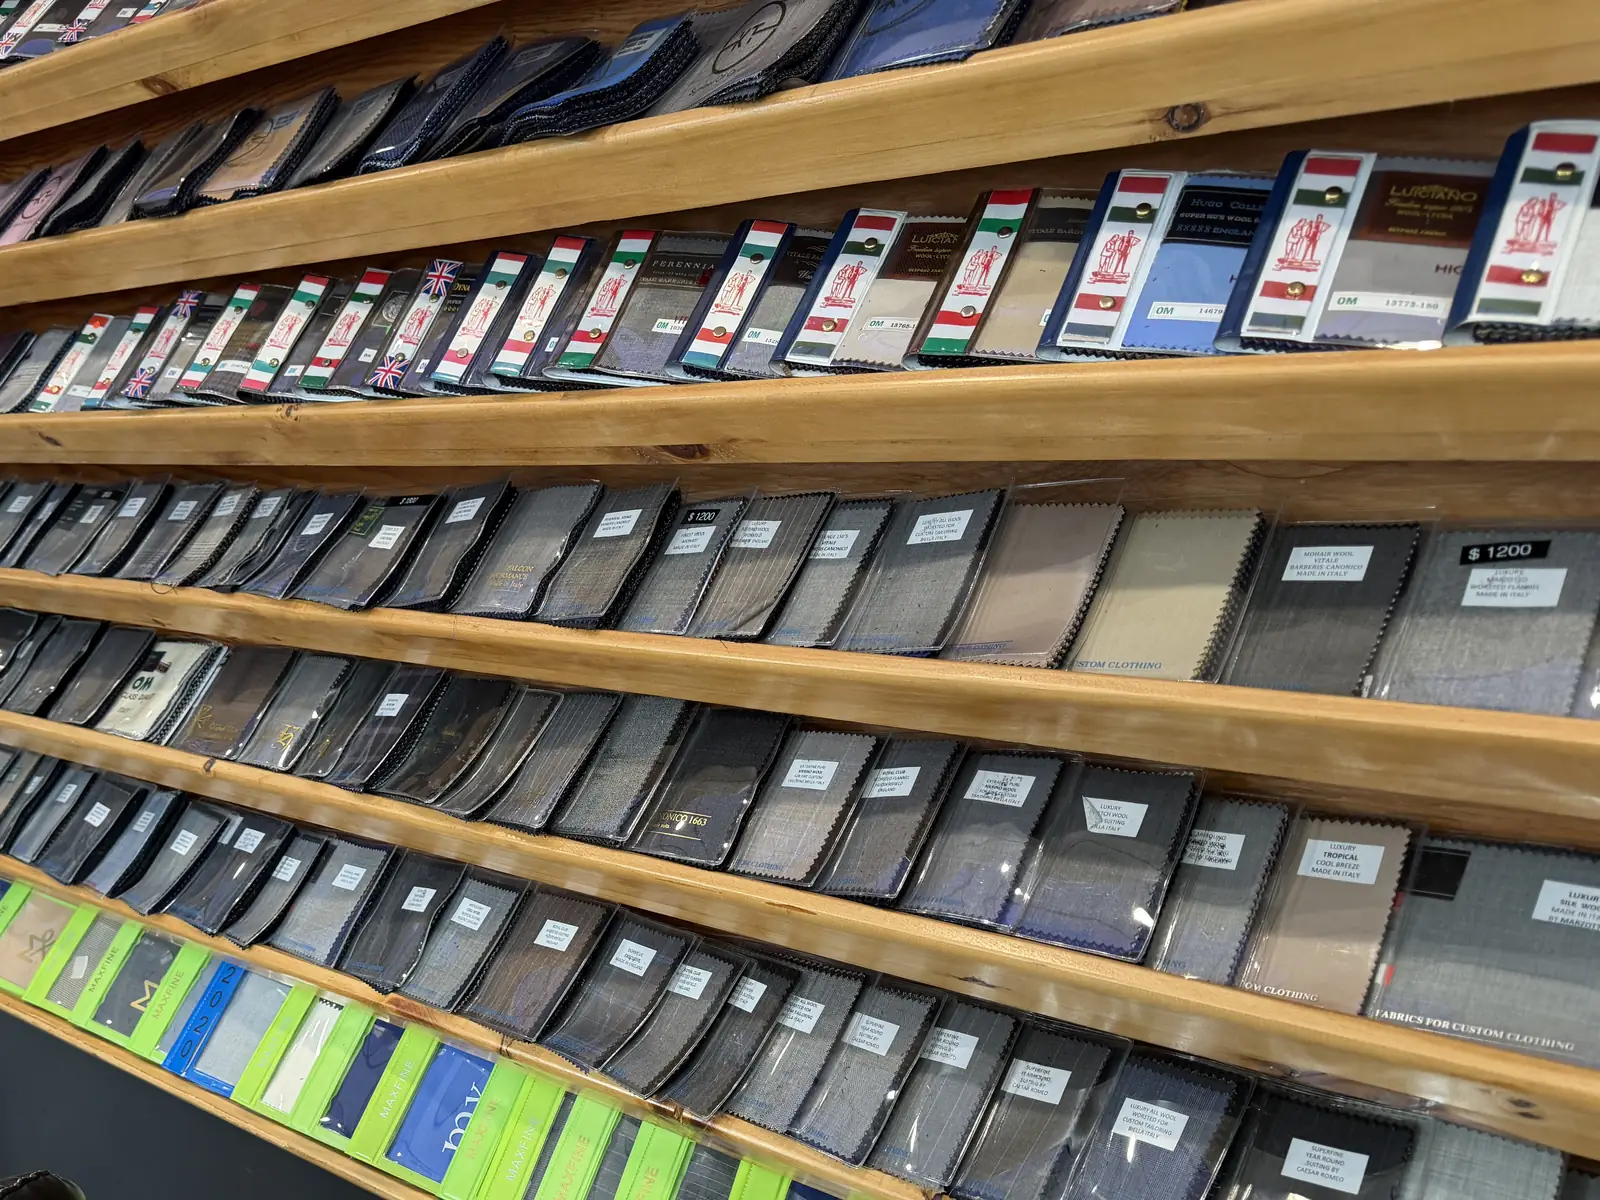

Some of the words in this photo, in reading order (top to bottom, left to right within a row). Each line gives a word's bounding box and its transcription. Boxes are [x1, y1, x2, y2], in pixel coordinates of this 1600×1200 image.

[1337, 296, 1358, 306] OM
[1156, 306, 1174, 315] OM
[870, 320, 883, 328] OM
[748, 330, 761, 338] OM
[688, 512, 694, 522] $
[695, 512, 716, 521] 1200
[1468, 548, 1480, 560] $
[1488, 544, 1532, 558] 1200
[1108, 661, 1163, 670] CLOTHING
[689, 816, 708, 826] 1663
[1104, 818, 1126, 826] SUITING
[1323, 852, 1359, 861] TROPICAL
[751, 860, 784, 871] CLOTHING
[1316, 859, 1334, 867] COOL
[1336, 862, 1361, 870] BREEZE
[1310, 867, 1331, 875] MADE
[1342, 871, 1362, 879] ITALY
[1560, 899, 1577, 907] SILK
[1551, 906, 1575, 916] MADE
[88, 945, 120, 994] MAXFINE
[151, 970, 185, 1021] MAXFINE
[1263, 986, 1319, 1002] CLOTHING
[1375, 1009, 1424, 1025] FABRICS
[1426, 1017, 1450, 1030] FOR
[1452, 1020, 1504, 1039] CUSTOM
[1506, 1032, 1576, 1052] CLOTHING
[380, 1060, 415, 1119] MAXFINE
[1130, 1103, 1150, 1114] LUXURY
[1160, 1112, 1177, 1122] WOOL
[1132, 1111, 1156, 1123] WORSTED
[1156, 1118, 1168, 1127] FOR
[1122, 1118, 1144, 1127] CUSTOM
[1144, 1122, 1172, 1136] TAILORING
[1145, 1131, 1160, 1140] ITALY
[506, 1117, 542, 1182] MAXFINE
[1311, 1146, 1344, 1158] SUPERFINE
[1306, 1152, 1321, 1160] YEAR
[1322, 1156, 1345, 1166] ROUND
[1306, 1160, 1330, 1171] SUITING
[1331, 1166, 1341, 1174] BY
[1296, 1166, 1320, 1177] CAESAR
[1320, 1172, 1344, 1183] ROMEO
